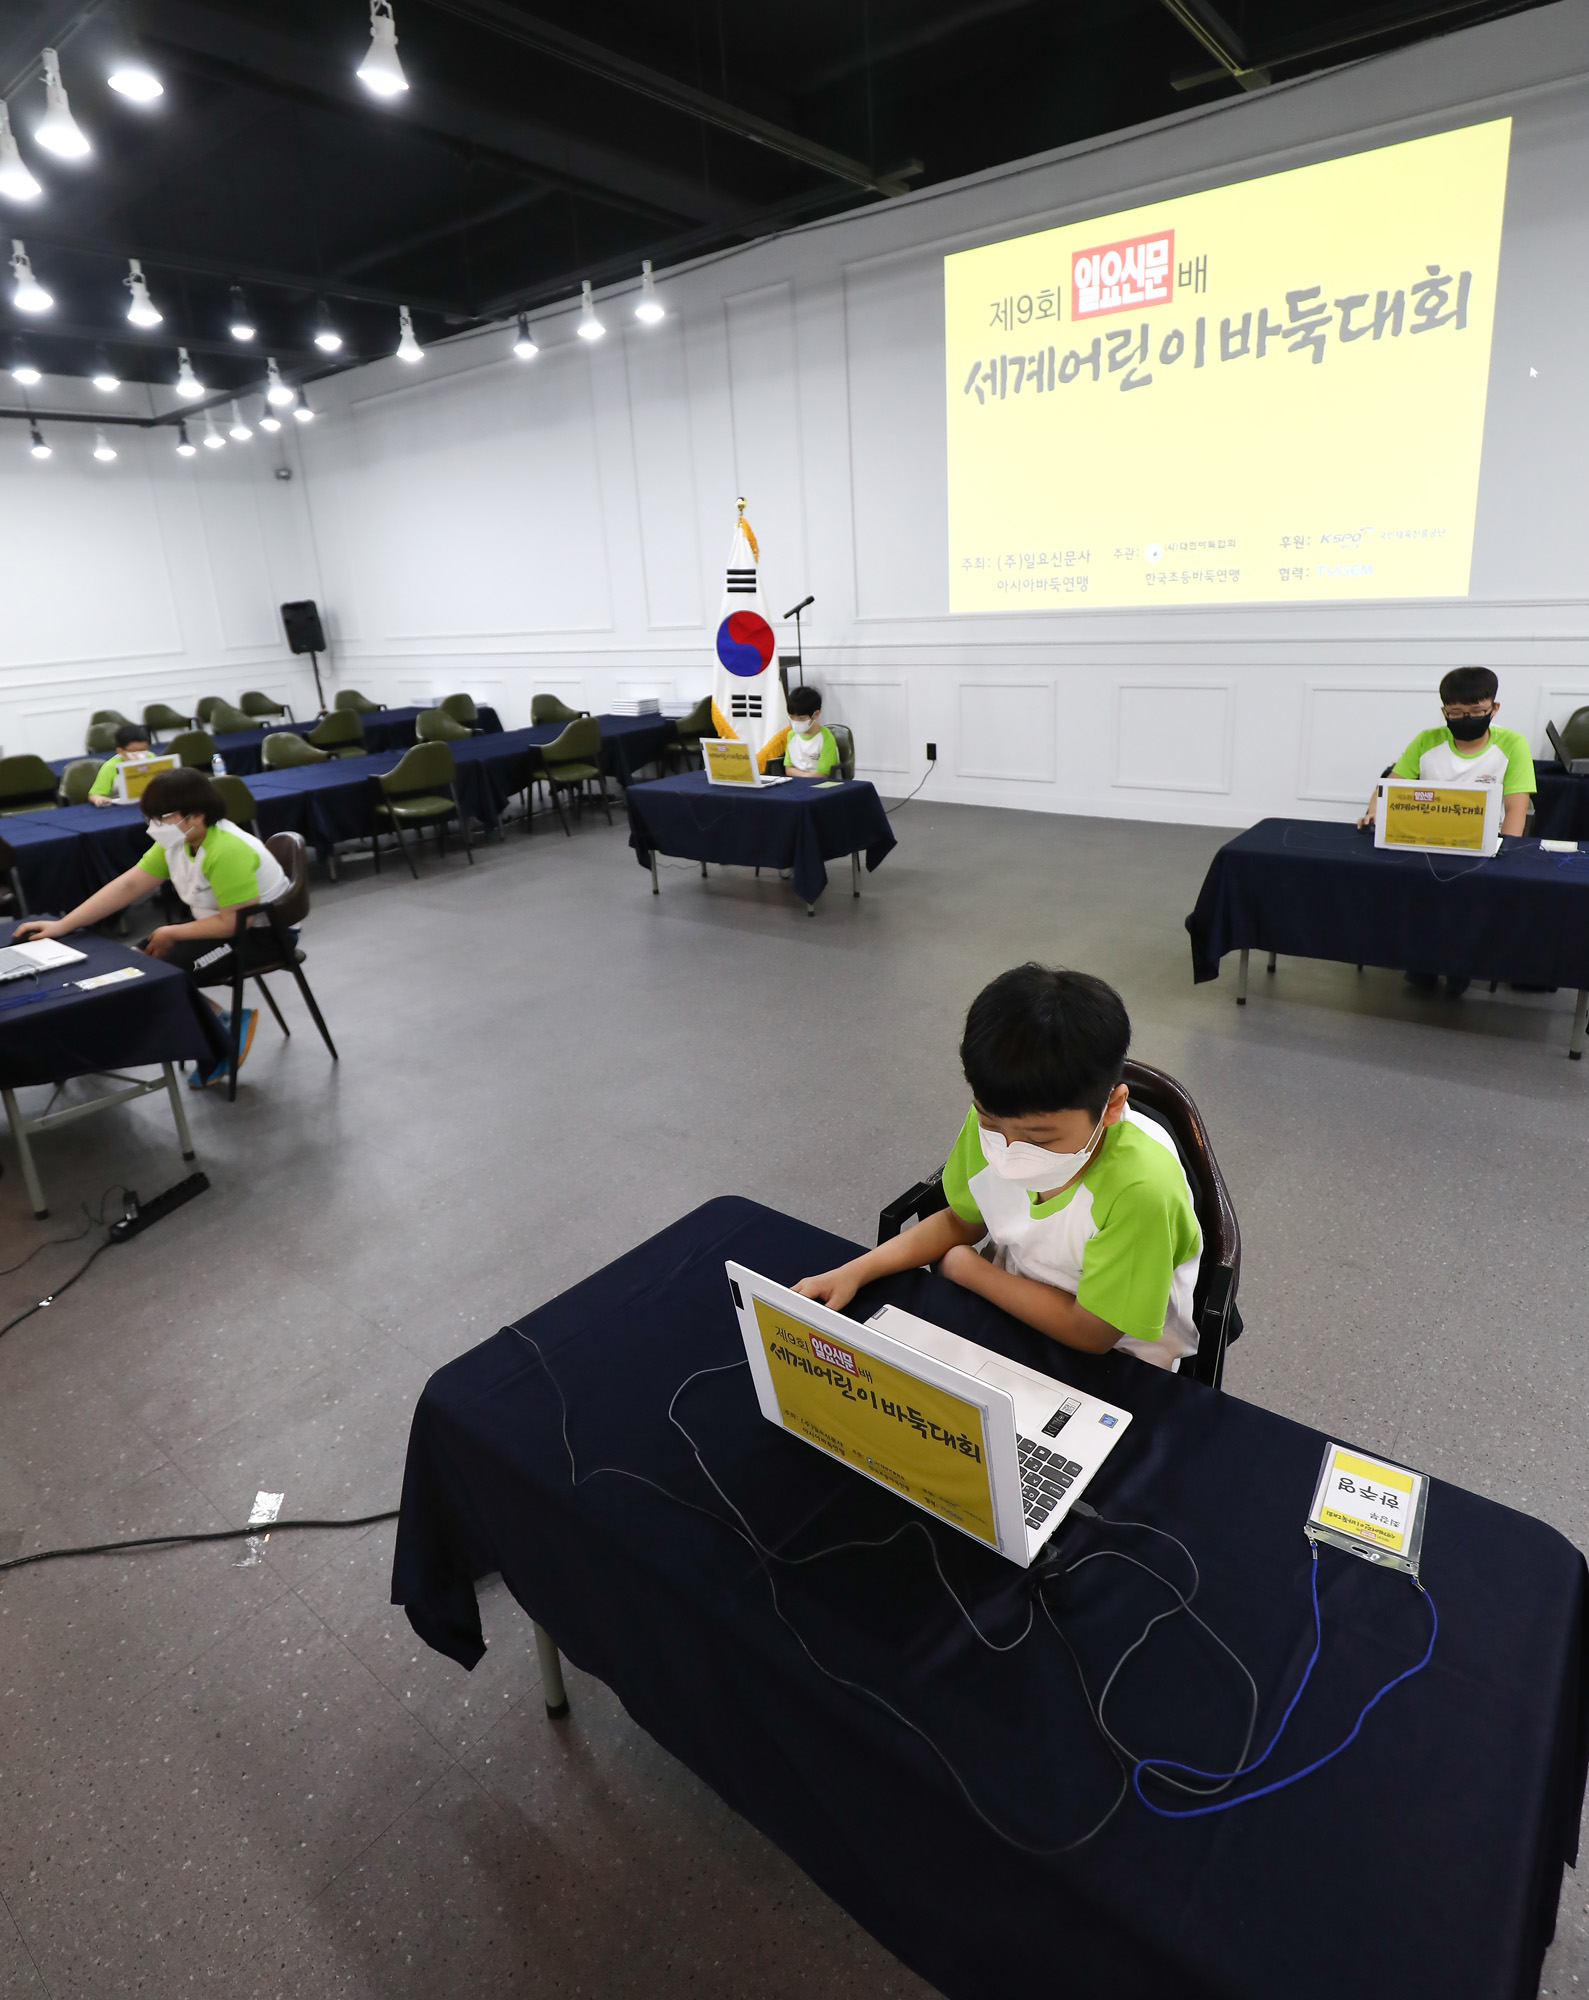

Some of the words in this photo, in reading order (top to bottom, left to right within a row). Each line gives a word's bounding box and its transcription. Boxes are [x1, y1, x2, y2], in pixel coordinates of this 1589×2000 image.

[988, 286, 1062, 332] 제9회
[1279, 535, 1311, 550] 후원:
[1320, 533, 1363, 544] KSPO
[997, 549, 1091, 572] (주)일요신문사
[996, 575, 1090, 594] 아시아바둑연맹
[1144, 568, 1241, 586] 한국초등바둑연맹
[1278, 566, 1310, 582] 협력:
[774, 1325, 810, 1353] 제9회
[1338, 1477, 1400, 1510] 한주영
